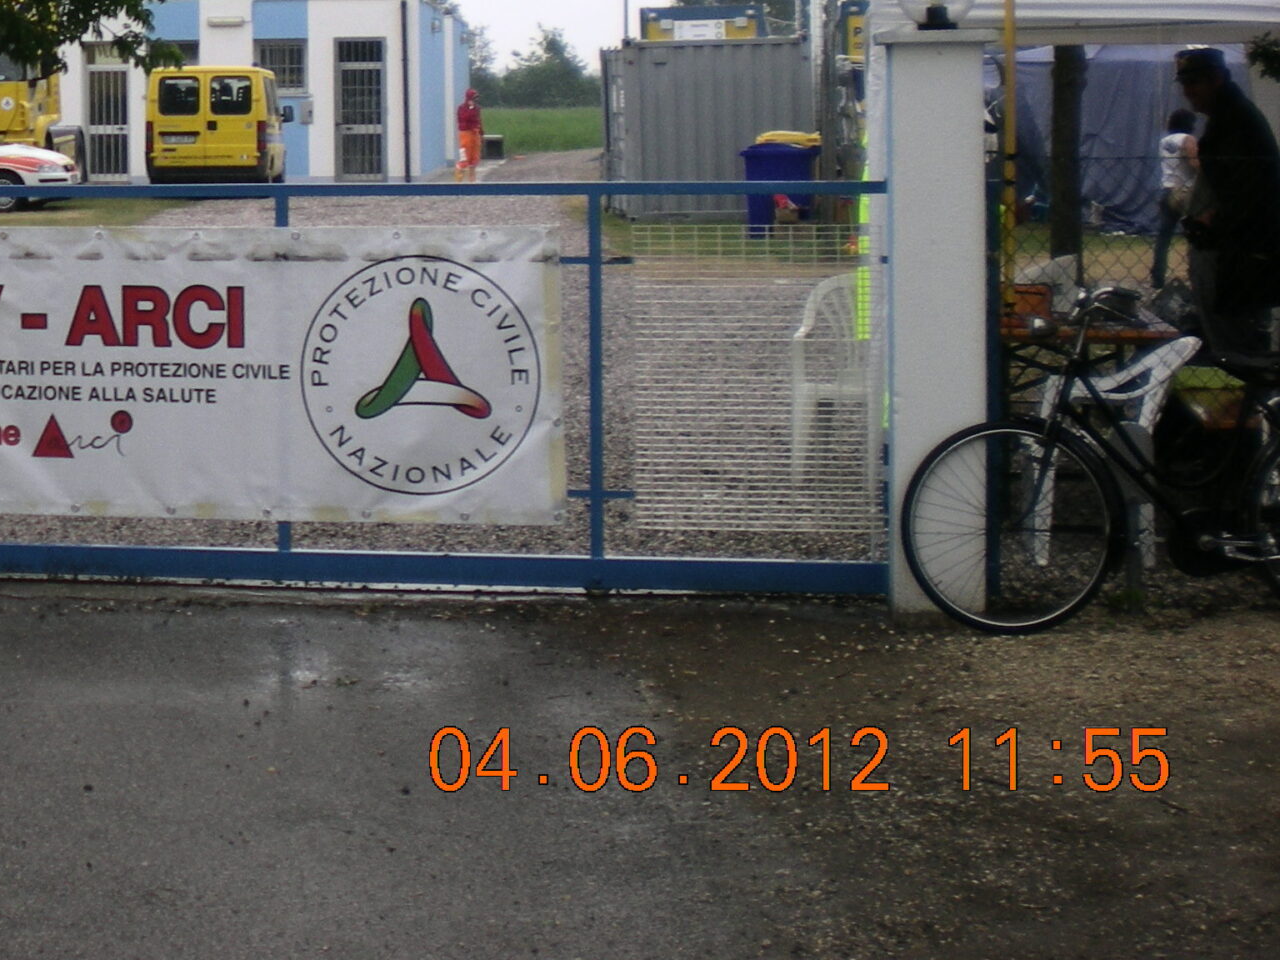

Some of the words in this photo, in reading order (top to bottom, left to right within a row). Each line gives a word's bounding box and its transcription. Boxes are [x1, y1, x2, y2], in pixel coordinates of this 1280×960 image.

[65, 284, 245, 349] ARCI
[311, 267, 462, 387] PROTEZIONE
[471, 288, 529, 385] CIVILE
[40, 361, 76, 376] PER
[81, 361, 104, 377] LA
[111, 362, 227, 379] PROTEZIONE
[232, 364, 291, 380] CIVILE
[88, 386, 136, 402] ALLA
[143, 387, 217, 404] SALUTE
[329, 425, 513, 483] NAZIONALE
